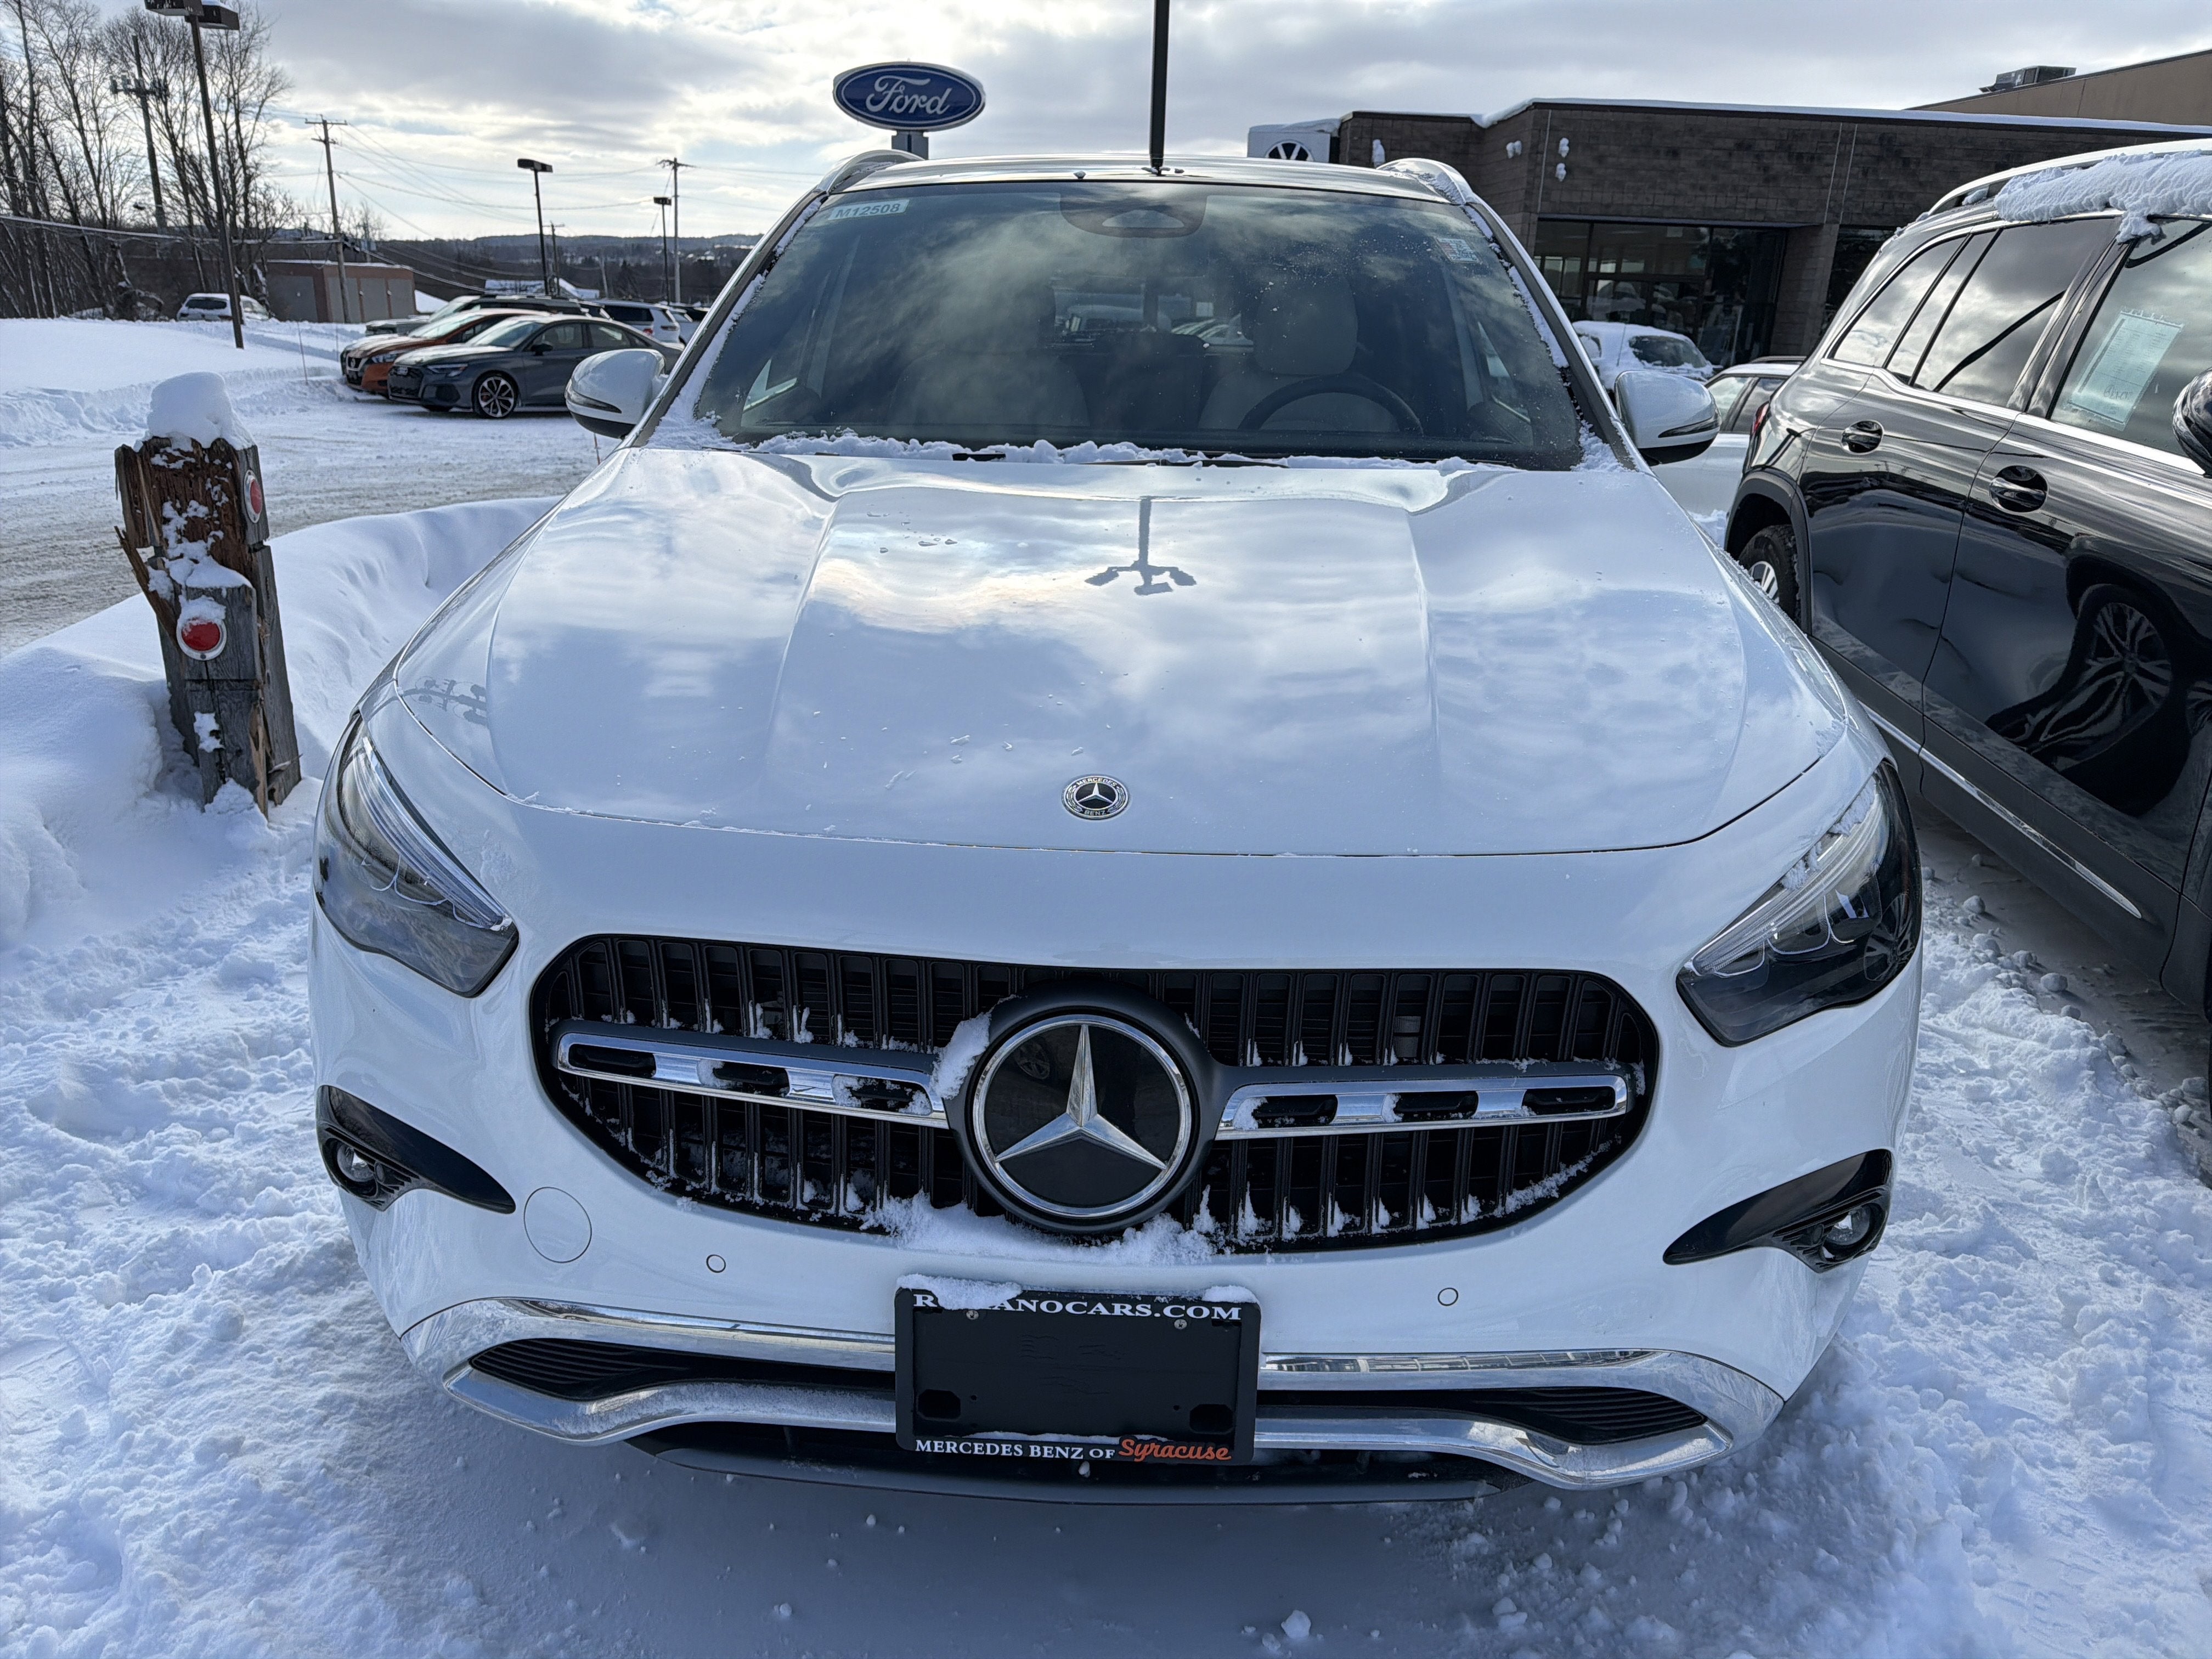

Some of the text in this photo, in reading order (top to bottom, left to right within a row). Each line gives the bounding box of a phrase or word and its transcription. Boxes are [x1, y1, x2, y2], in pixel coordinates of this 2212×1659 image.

[866, 75, 952, 115] Ford
[835, 202, 901, 218] M12508
[1076, 777, 1117, 787] MERCEDES
[913, 1294, 1242, 1319] RANOCARS.COM
[915, 1438, 1232, 1462] MERCEDES BENZ OF Syracuse
